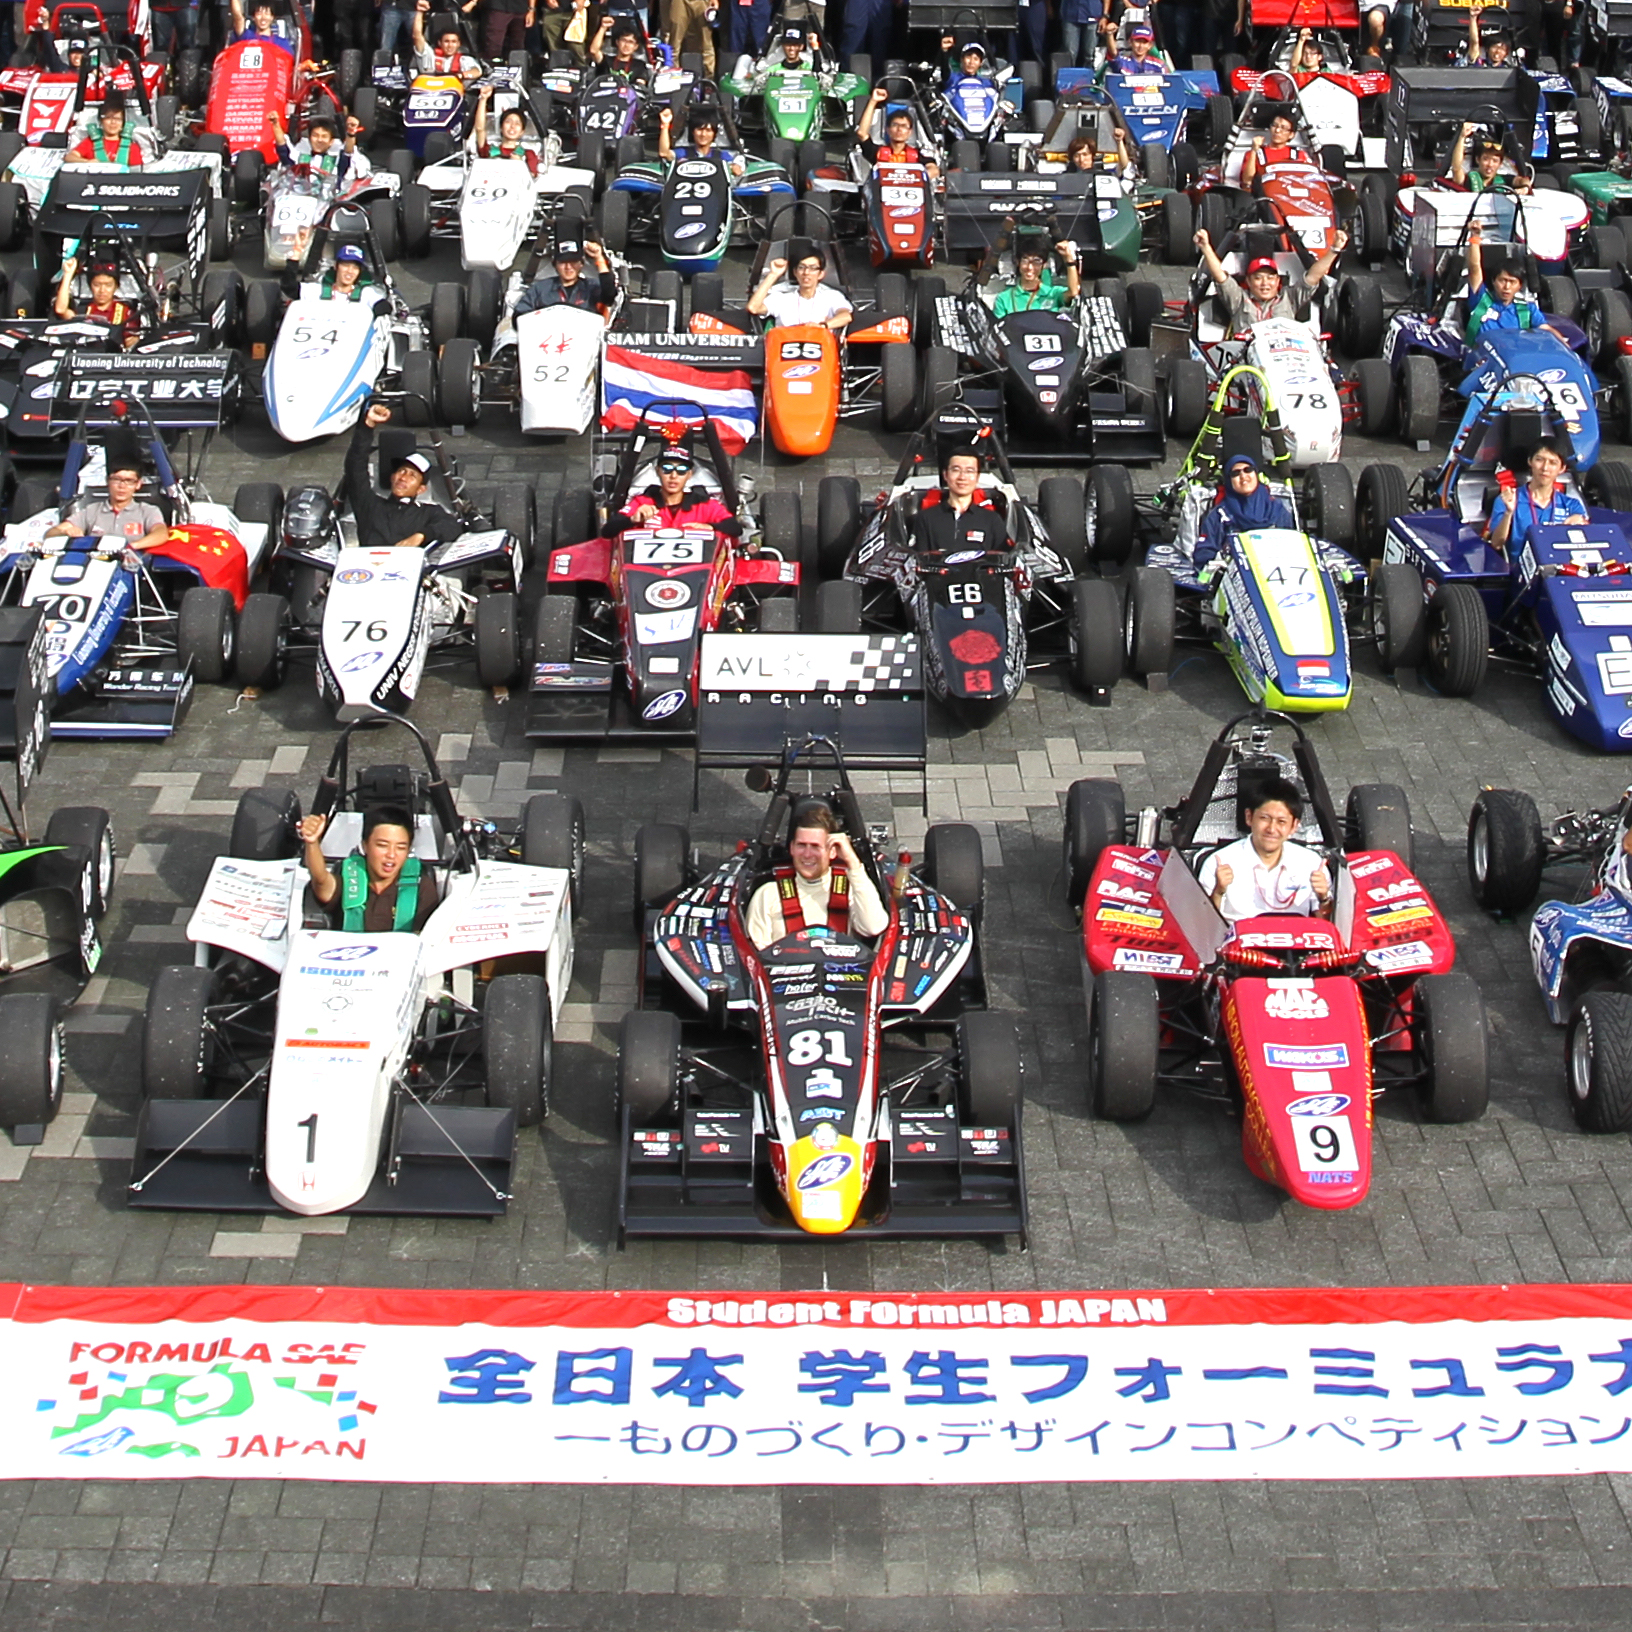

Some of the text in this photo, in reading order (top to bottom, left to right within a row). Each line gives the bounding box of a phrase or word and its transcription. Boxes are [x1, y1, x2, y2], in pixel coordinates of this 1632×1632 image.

[585, 111, 616, 130] 42
[98, 184, 181, 197] SOLIDWORKS
[470, 187, 508, 200] 60
[673, 182, 712, 200] 29
[278, 207, 308, 222] 65
[292, 327, 339, 345] 54
[606, 331, 760, 348] SIAM UNIVERSITY
[1028, 334, 1059, 352] 31
[780, 343, 822, 359] 55
[113, 355, 164, 370] University
[165, 355, 177, 368] of
[533, 365, 570, 382] 52
[1286, 393, 1328, 409] 78
[637, 542, 695, 560] 75
[1265, 565, 1309, 587] 47
[948, 583, 983, 604] E6
[37, 596, 87, 619] 70
[340, 619, 389, 644] 76
[716, 657, 774, 677] AVL
[786, 1029, 854, 1067] 81
[297, 1112, 320, 1164] 1
[1308, 1124, 1341, 1164] 9
[1307, 1171, 1354, 1185] NATS
[667, 1296, 1168, 1327] Student Formula JAPAN
[69, 1337, 271, 1367] FORMULA
[435, 1345, 746, 1407] 全日本
[216, 1435, 367, 1461] JAPAN
